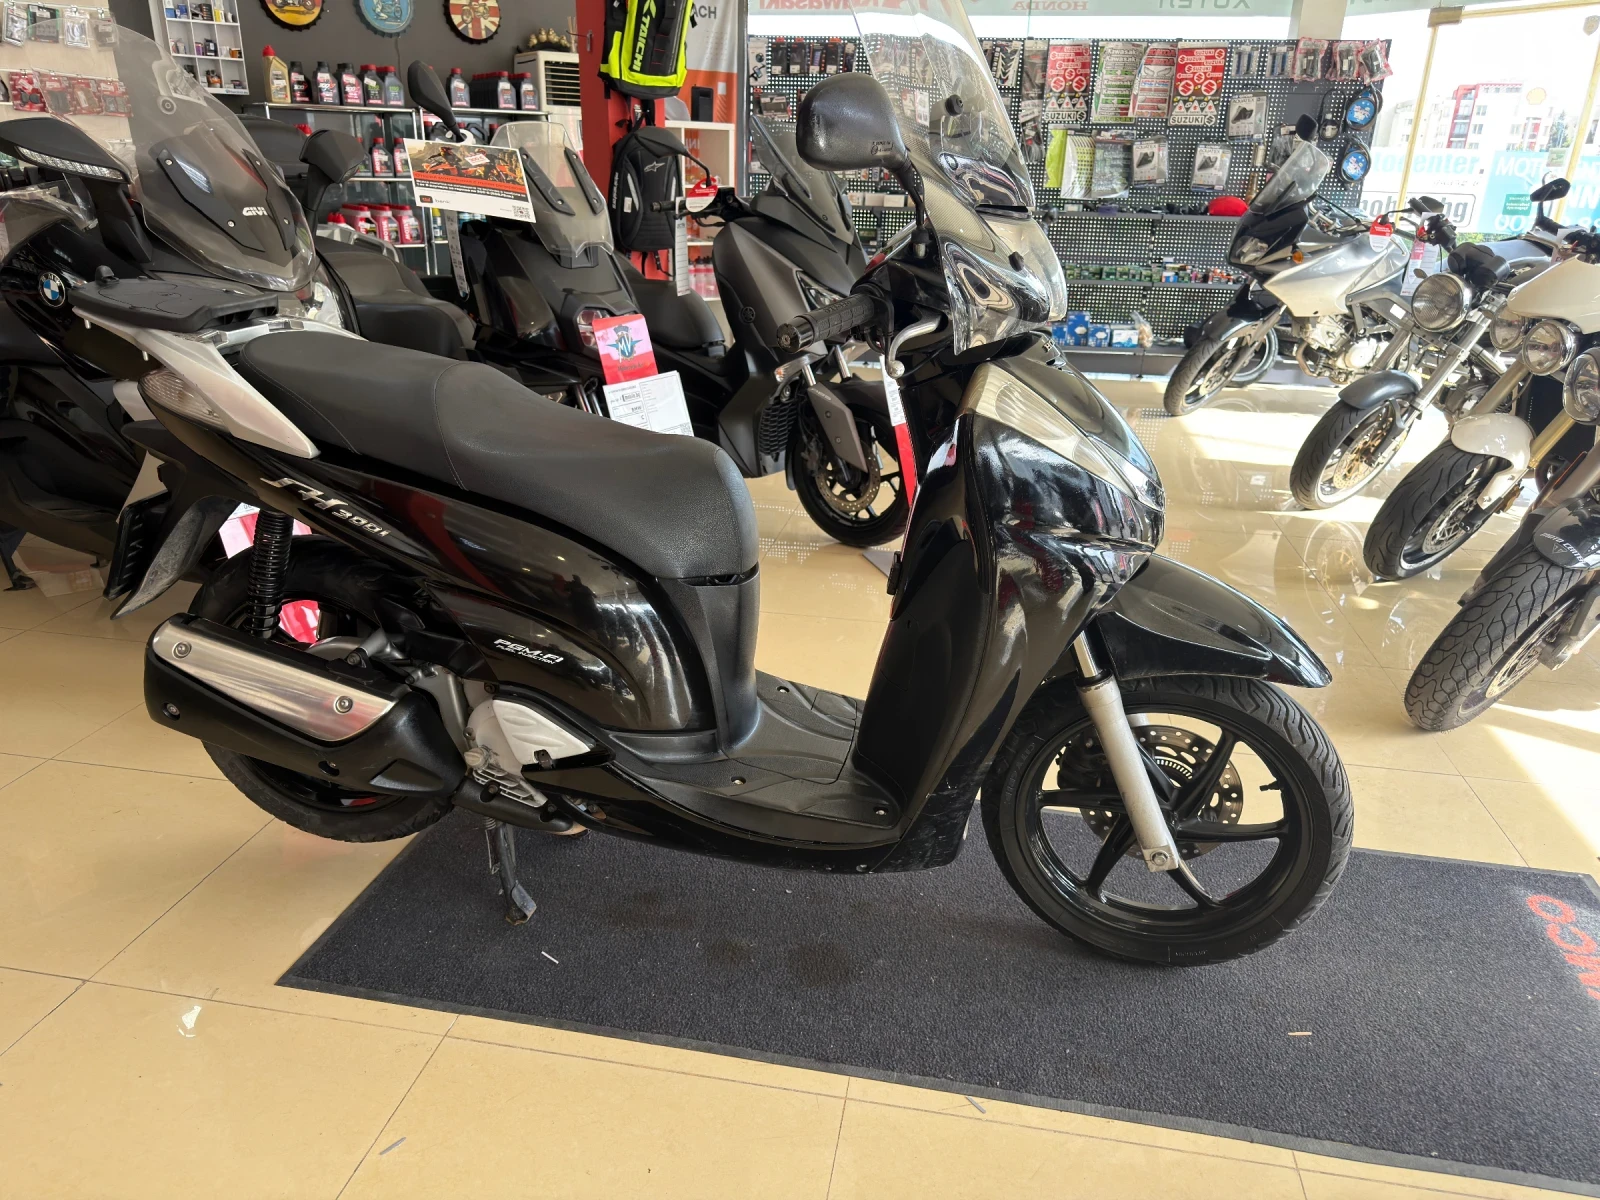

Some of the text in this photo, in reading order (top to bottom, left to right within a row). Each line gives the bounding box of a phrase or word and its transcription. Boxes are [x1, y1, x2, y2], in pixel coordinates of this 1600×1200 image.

[632, 14, 651, 72] TAICHI
[1044, 112, 1075, 121] SUZUKI
[1170, 115, 1204, 125] SUZUKI
[242, 206, 268, 217] GIVI
[382, 219, 390, 241] MOTUL
